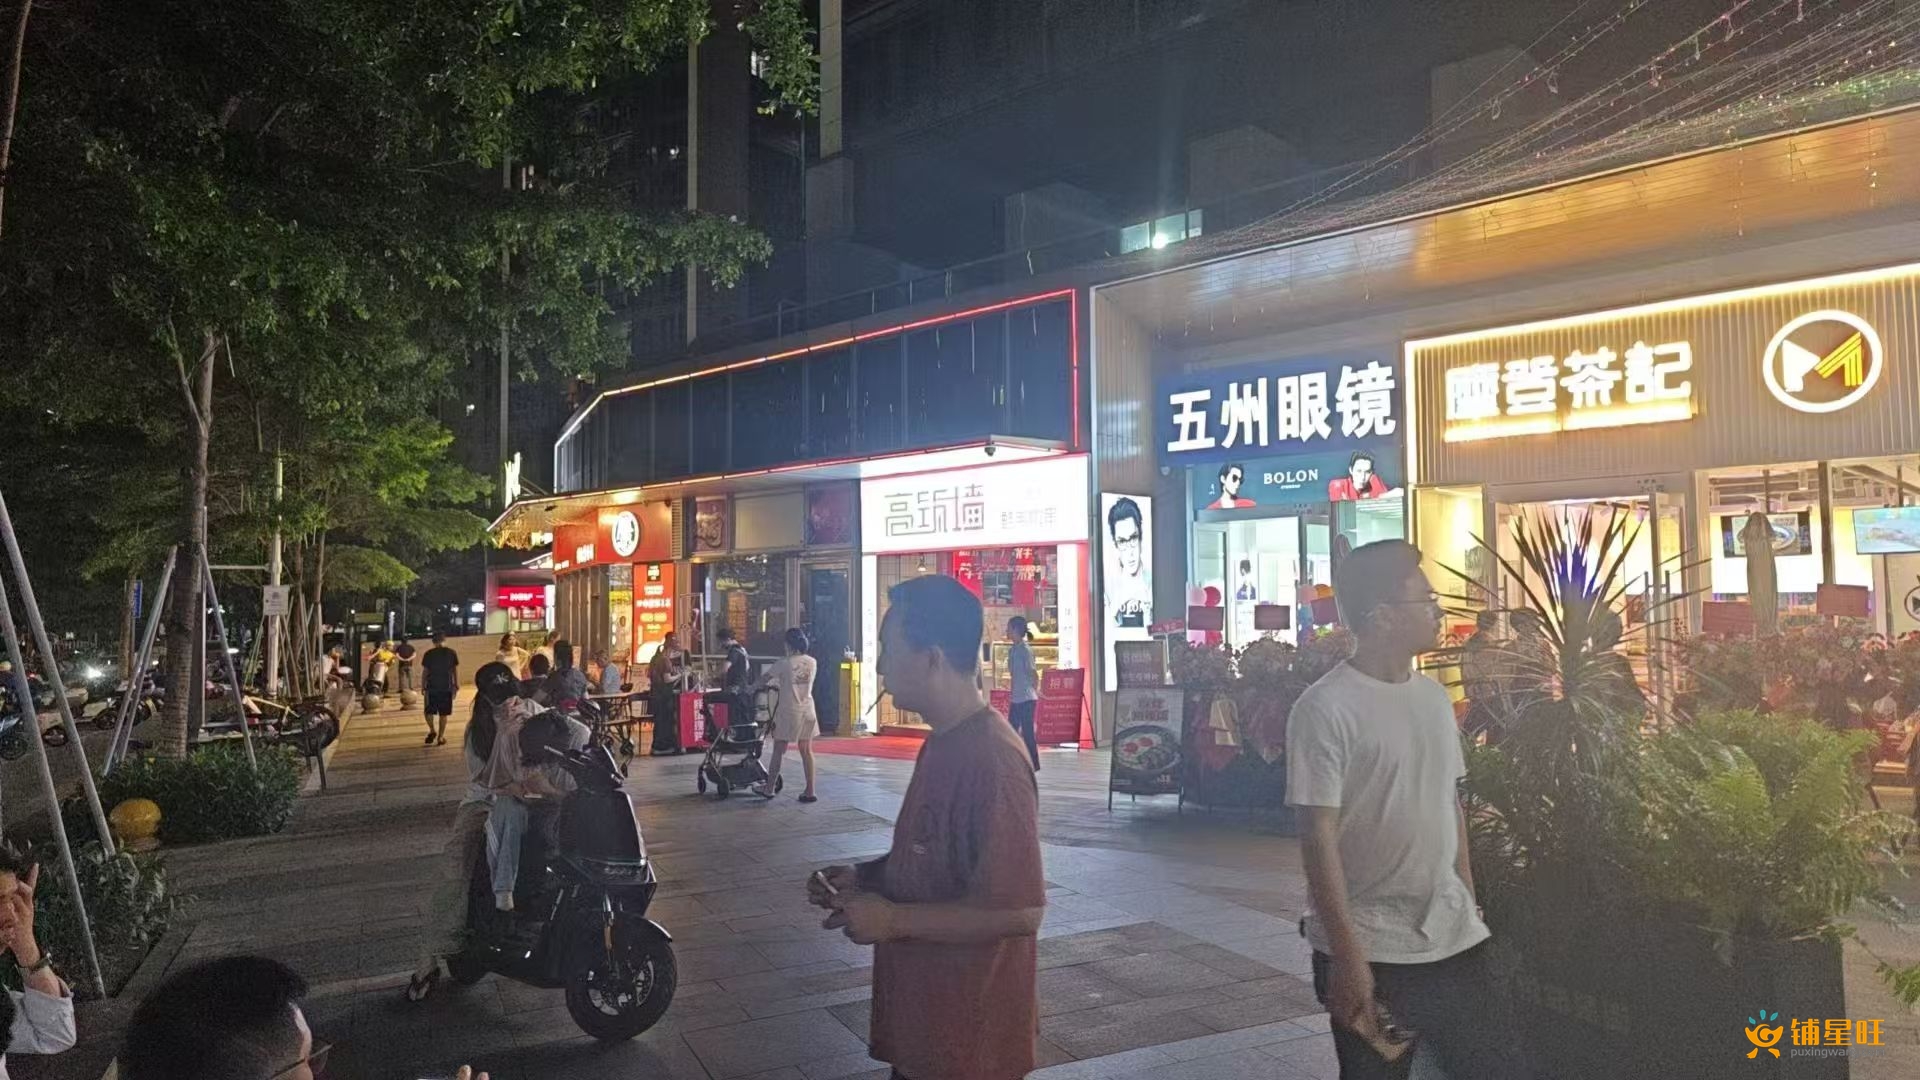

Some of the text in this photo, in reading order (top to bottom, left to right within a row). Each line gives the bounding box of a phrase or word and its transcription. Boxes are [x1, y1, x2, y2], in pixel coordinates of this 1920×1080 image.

[1167, 360, 1396, 452] 五州眼镜
[1263, 468, 1319, 486] BOLON
